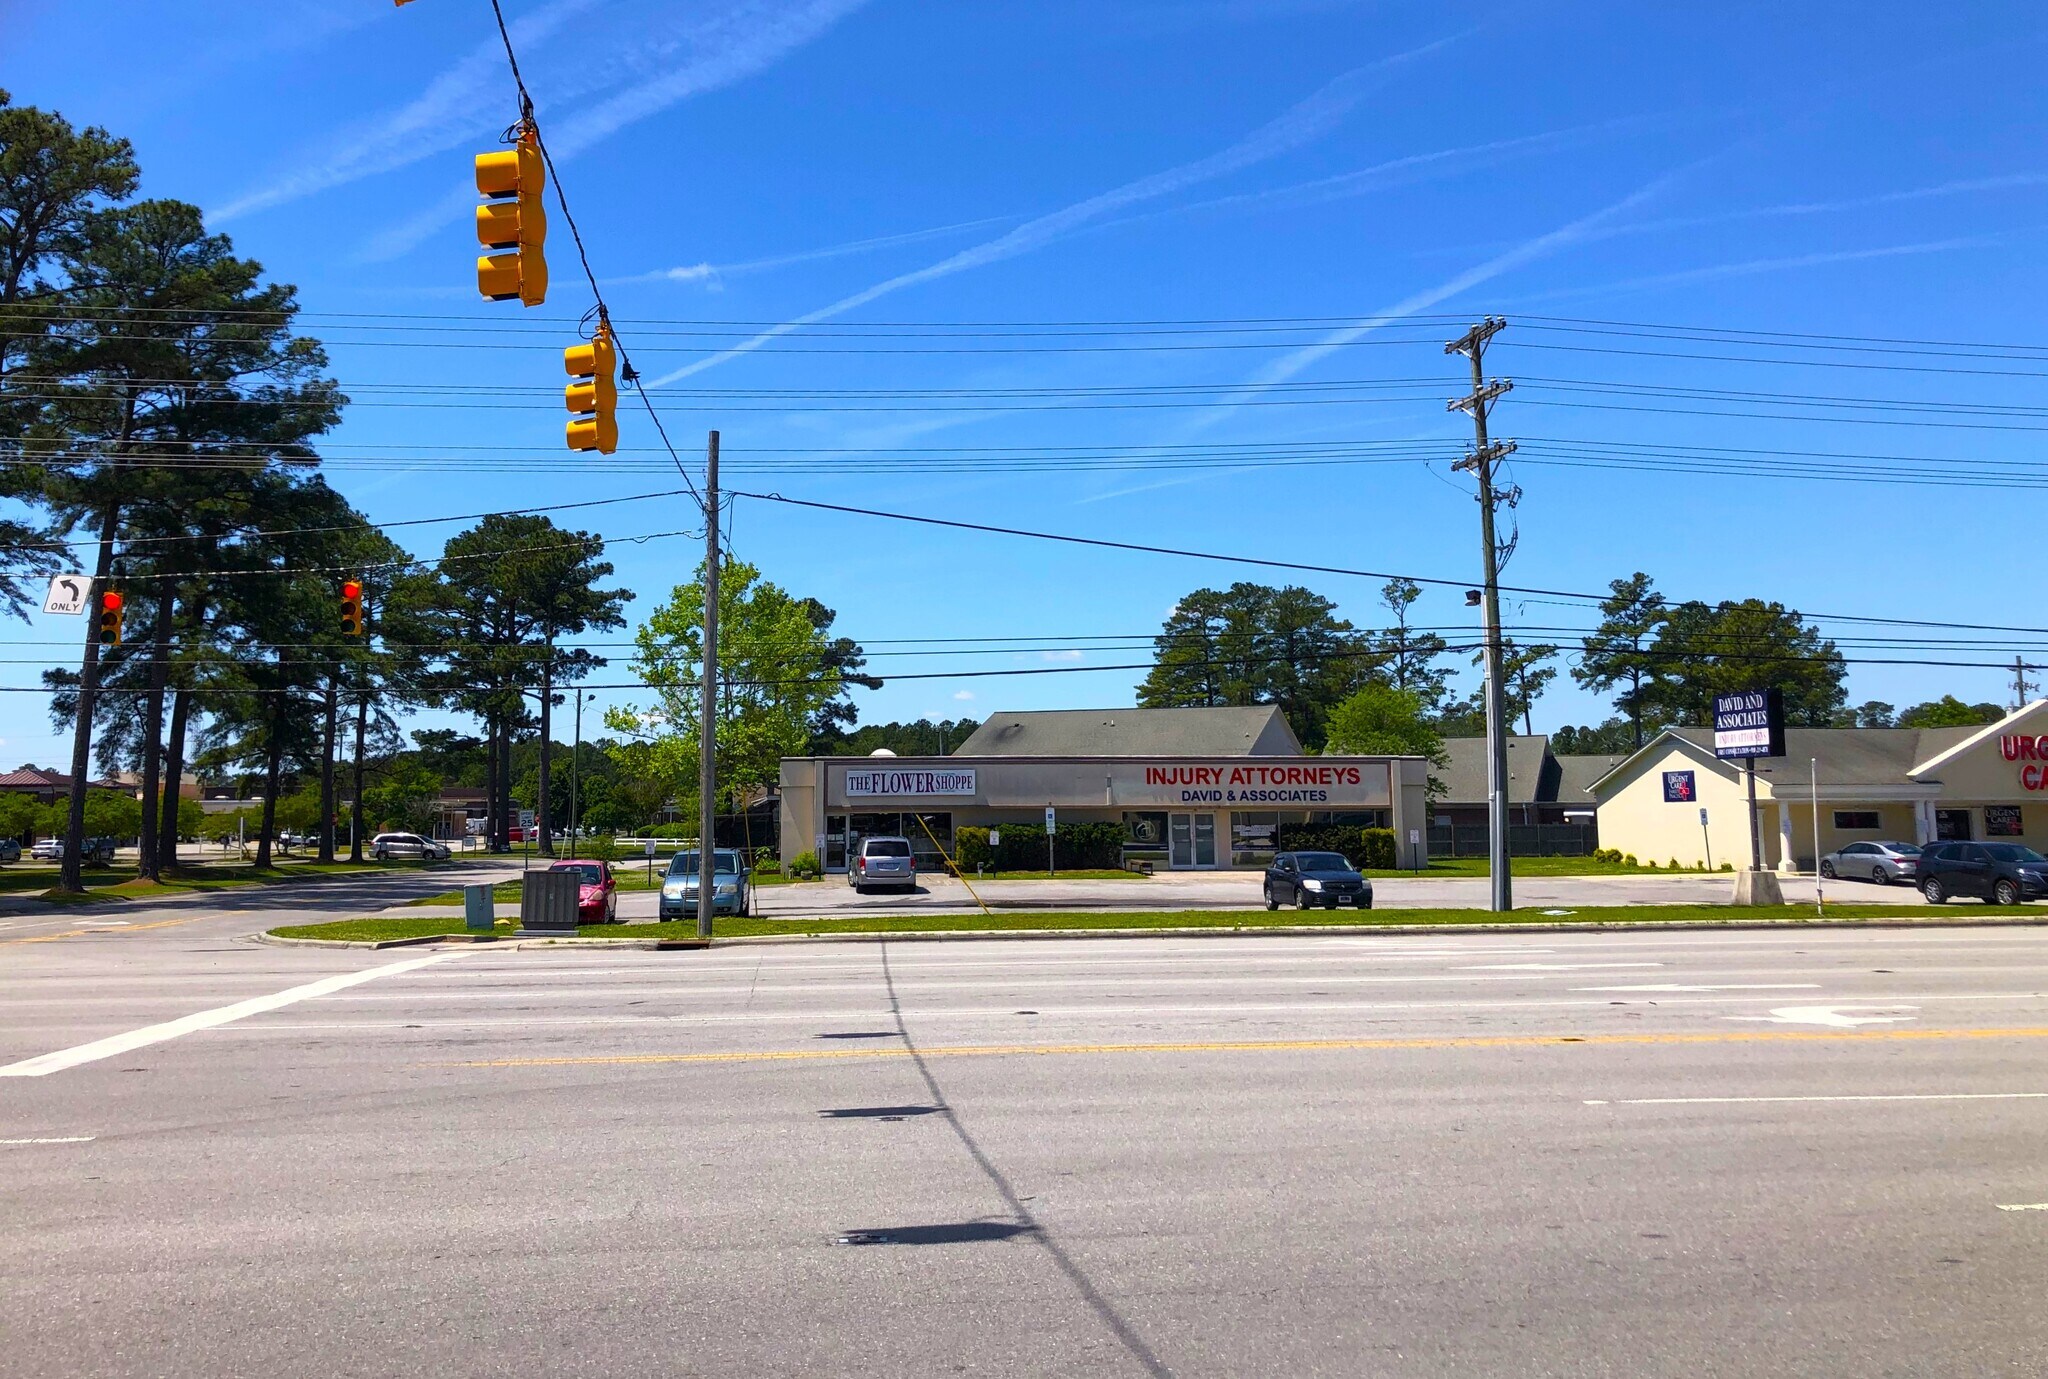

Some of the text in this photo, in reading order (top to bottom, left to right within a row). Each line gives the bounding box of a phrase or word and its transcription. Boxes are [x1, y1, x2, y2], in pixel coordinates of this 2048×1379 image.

[50, 602, 80, 612] ONLY
[1718, 694, 1763, 713] DAVID AND
[1717, 711, 1767, 728] ASSOCIATES
[1146, 767, 1361, 785] INJURY ATTORNEYS
[1668, 774, 1688, 783] URGENT
[849, 772, 973, 793] THE FLOWER SHOPPE
[1181, 790, 1327, 802] DAVID & ASSOCIATES
[1985, 809, 2020, 818] URGENT
[521, 819, 533, 827] 25
